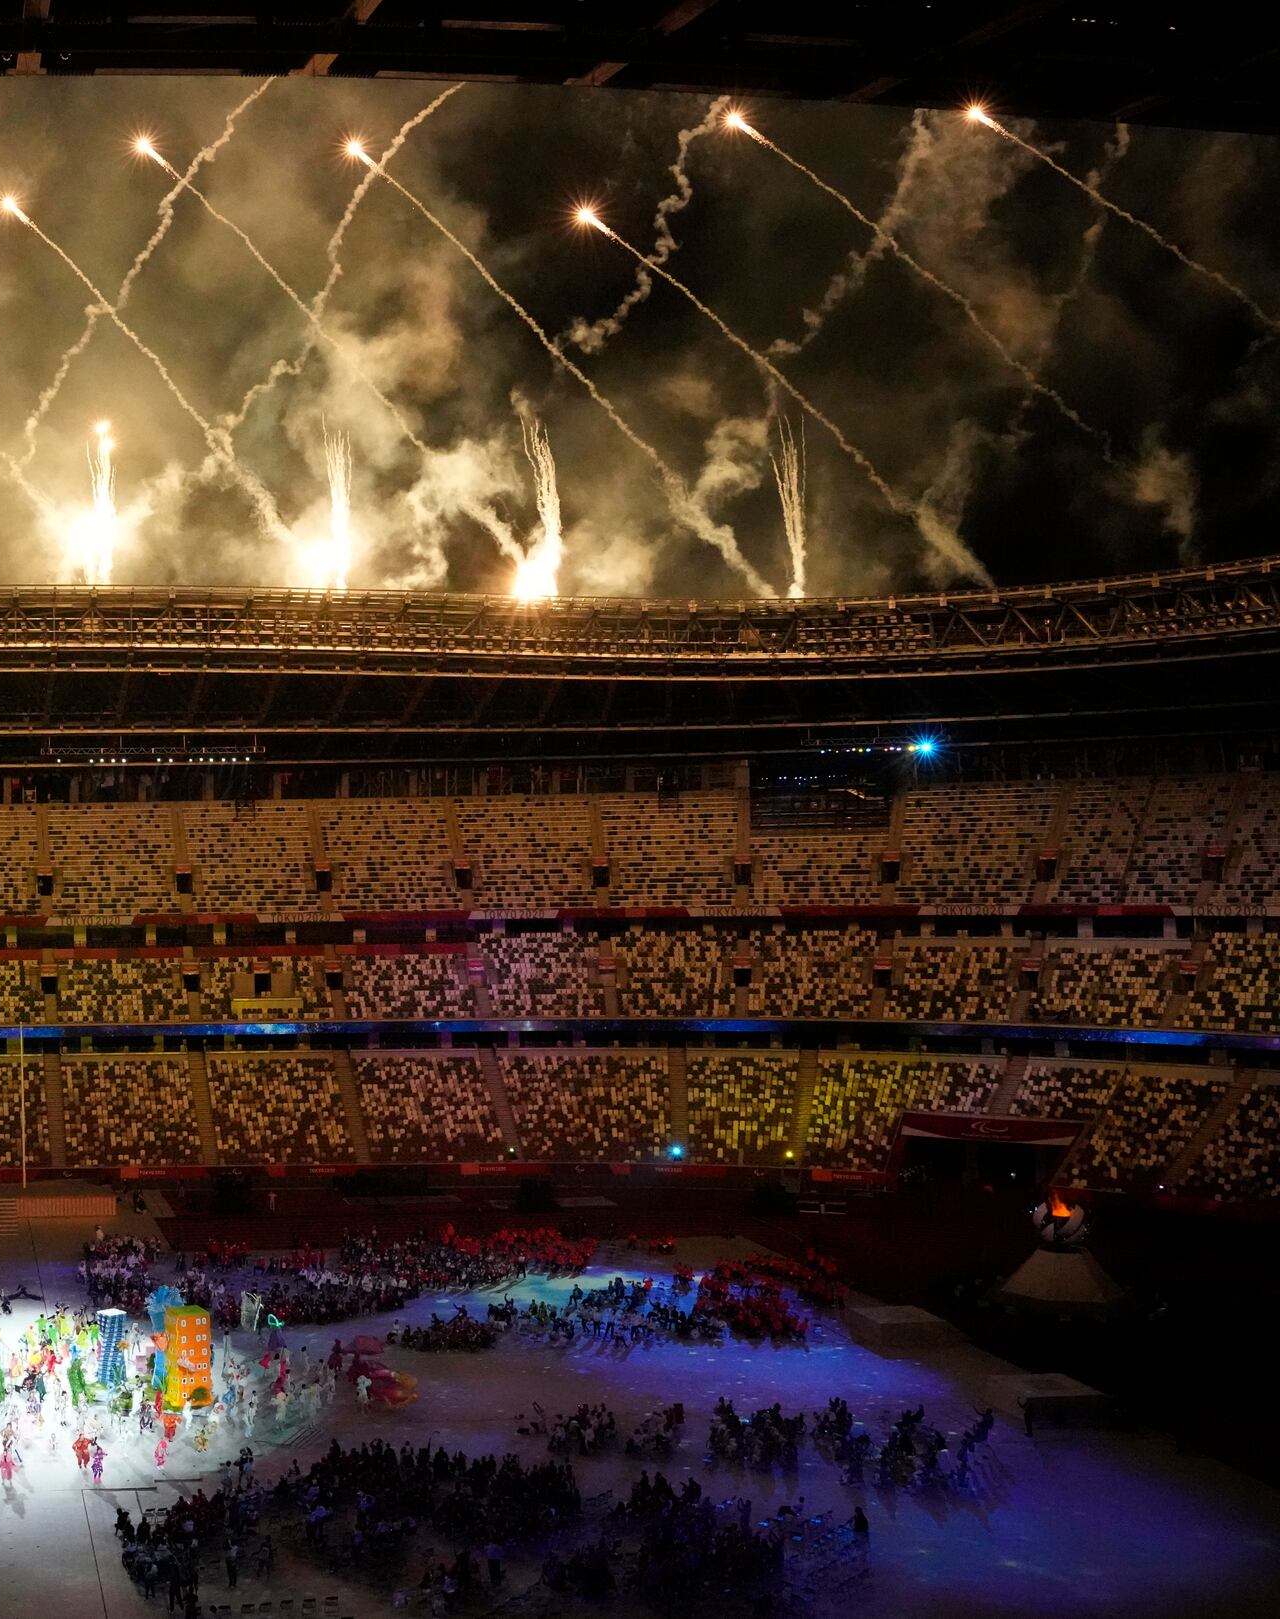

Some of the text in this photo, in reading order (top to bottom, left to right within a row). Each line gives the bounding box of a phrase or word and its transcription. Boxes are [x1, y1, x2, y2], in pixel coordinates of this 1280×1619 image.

[483, 909, 545, 919] TOKYO 2020
[703, 907, 767, 916] TOKYO 2020
[934, 905, 1004, 915] TOKYO 2020
[1190, 905, 1267, 916] TOKYO 2020
[59, 915, 120, 926] TOKYO 2020
[271, 913, 331, 922] TOKYO 2020
